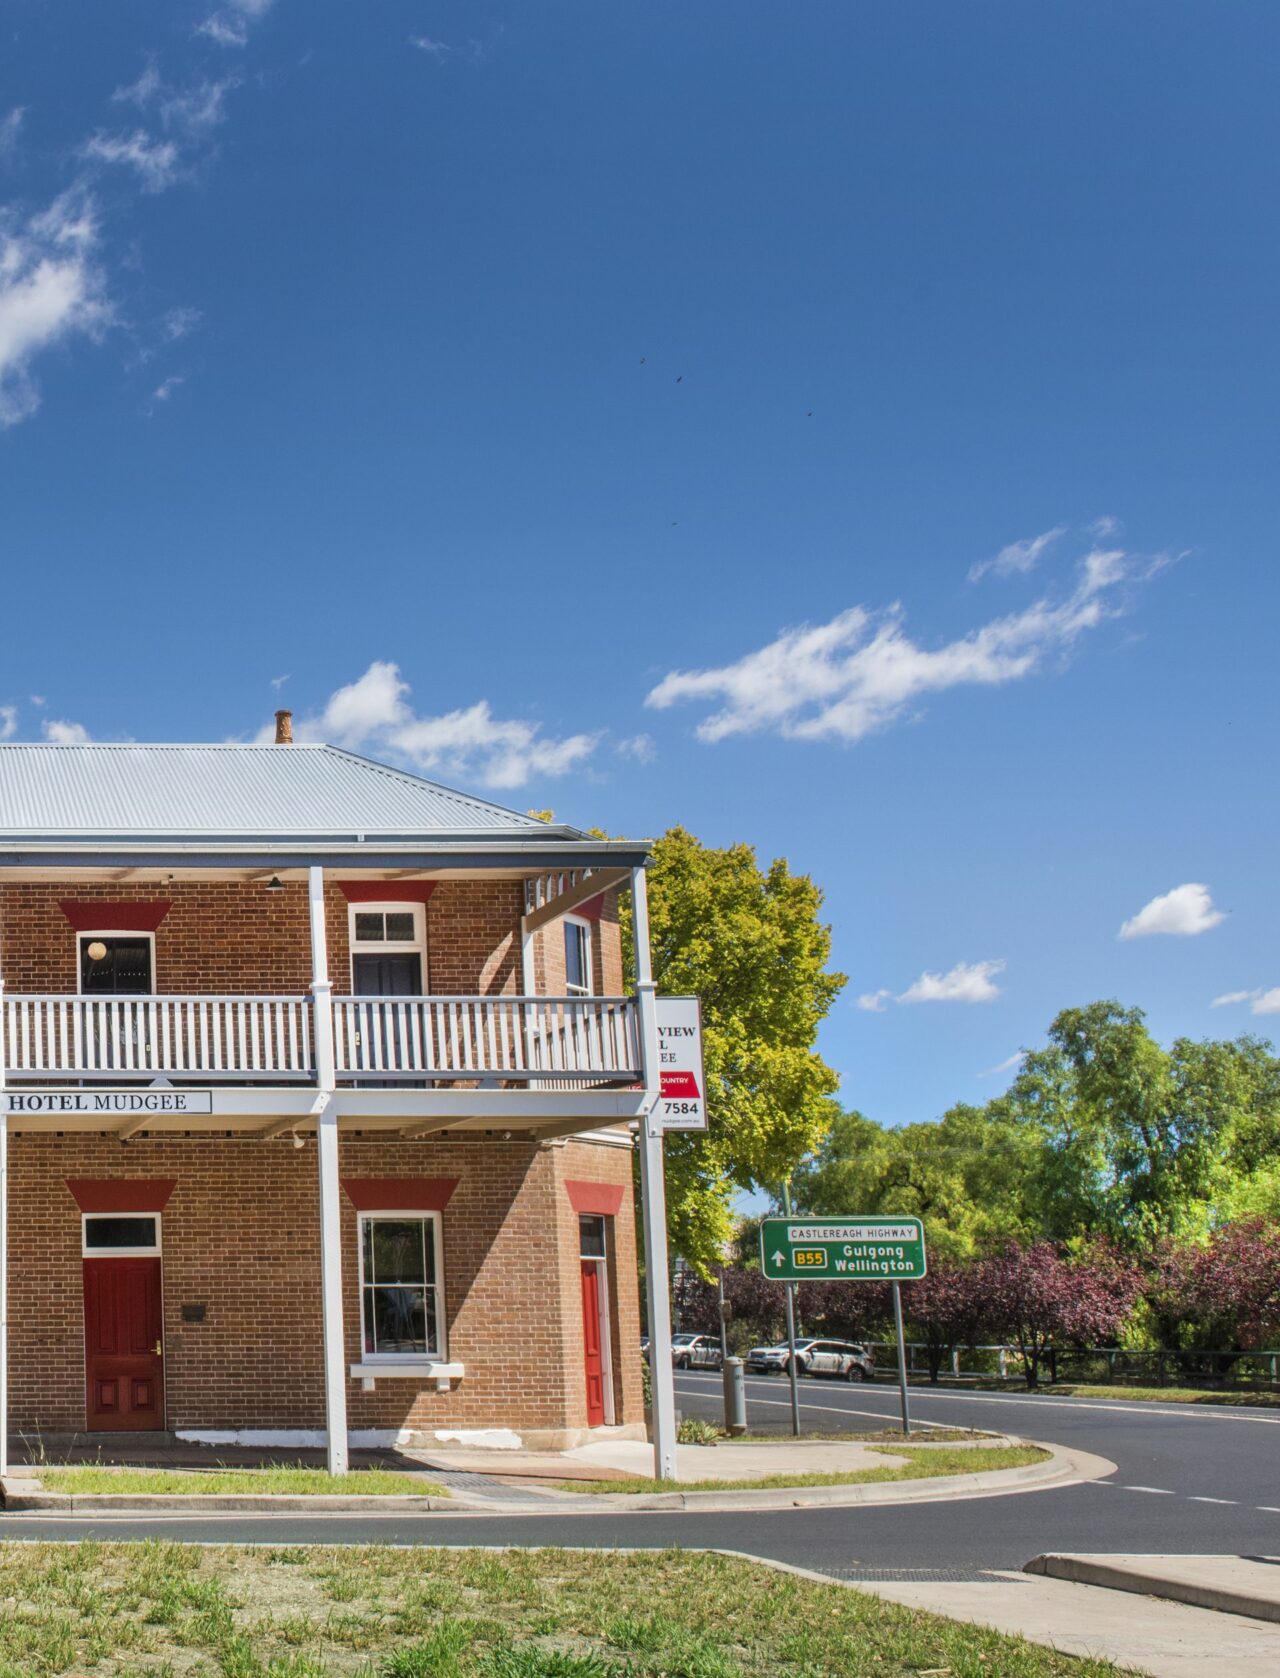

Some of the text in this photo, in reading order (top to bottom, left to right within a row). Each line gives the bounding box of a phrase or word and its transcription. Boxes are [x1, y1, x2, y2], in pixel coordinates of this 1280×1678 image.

[657, 1027, 696, 1037] VIEW
[8, 1095, 88, 1111] HOTEL
[94, 1095, 187, 1111] MUDGEE
[664, 1102, 699, 1114] 7584
[791, 1229, 913, 1238] CASTLEREAGH HIGHWAY
[843, 1245, 904, 1258] Gulgong
[796, 1252, 823, 1265] B55
[834, 1259, 914, 1274] Wellington
